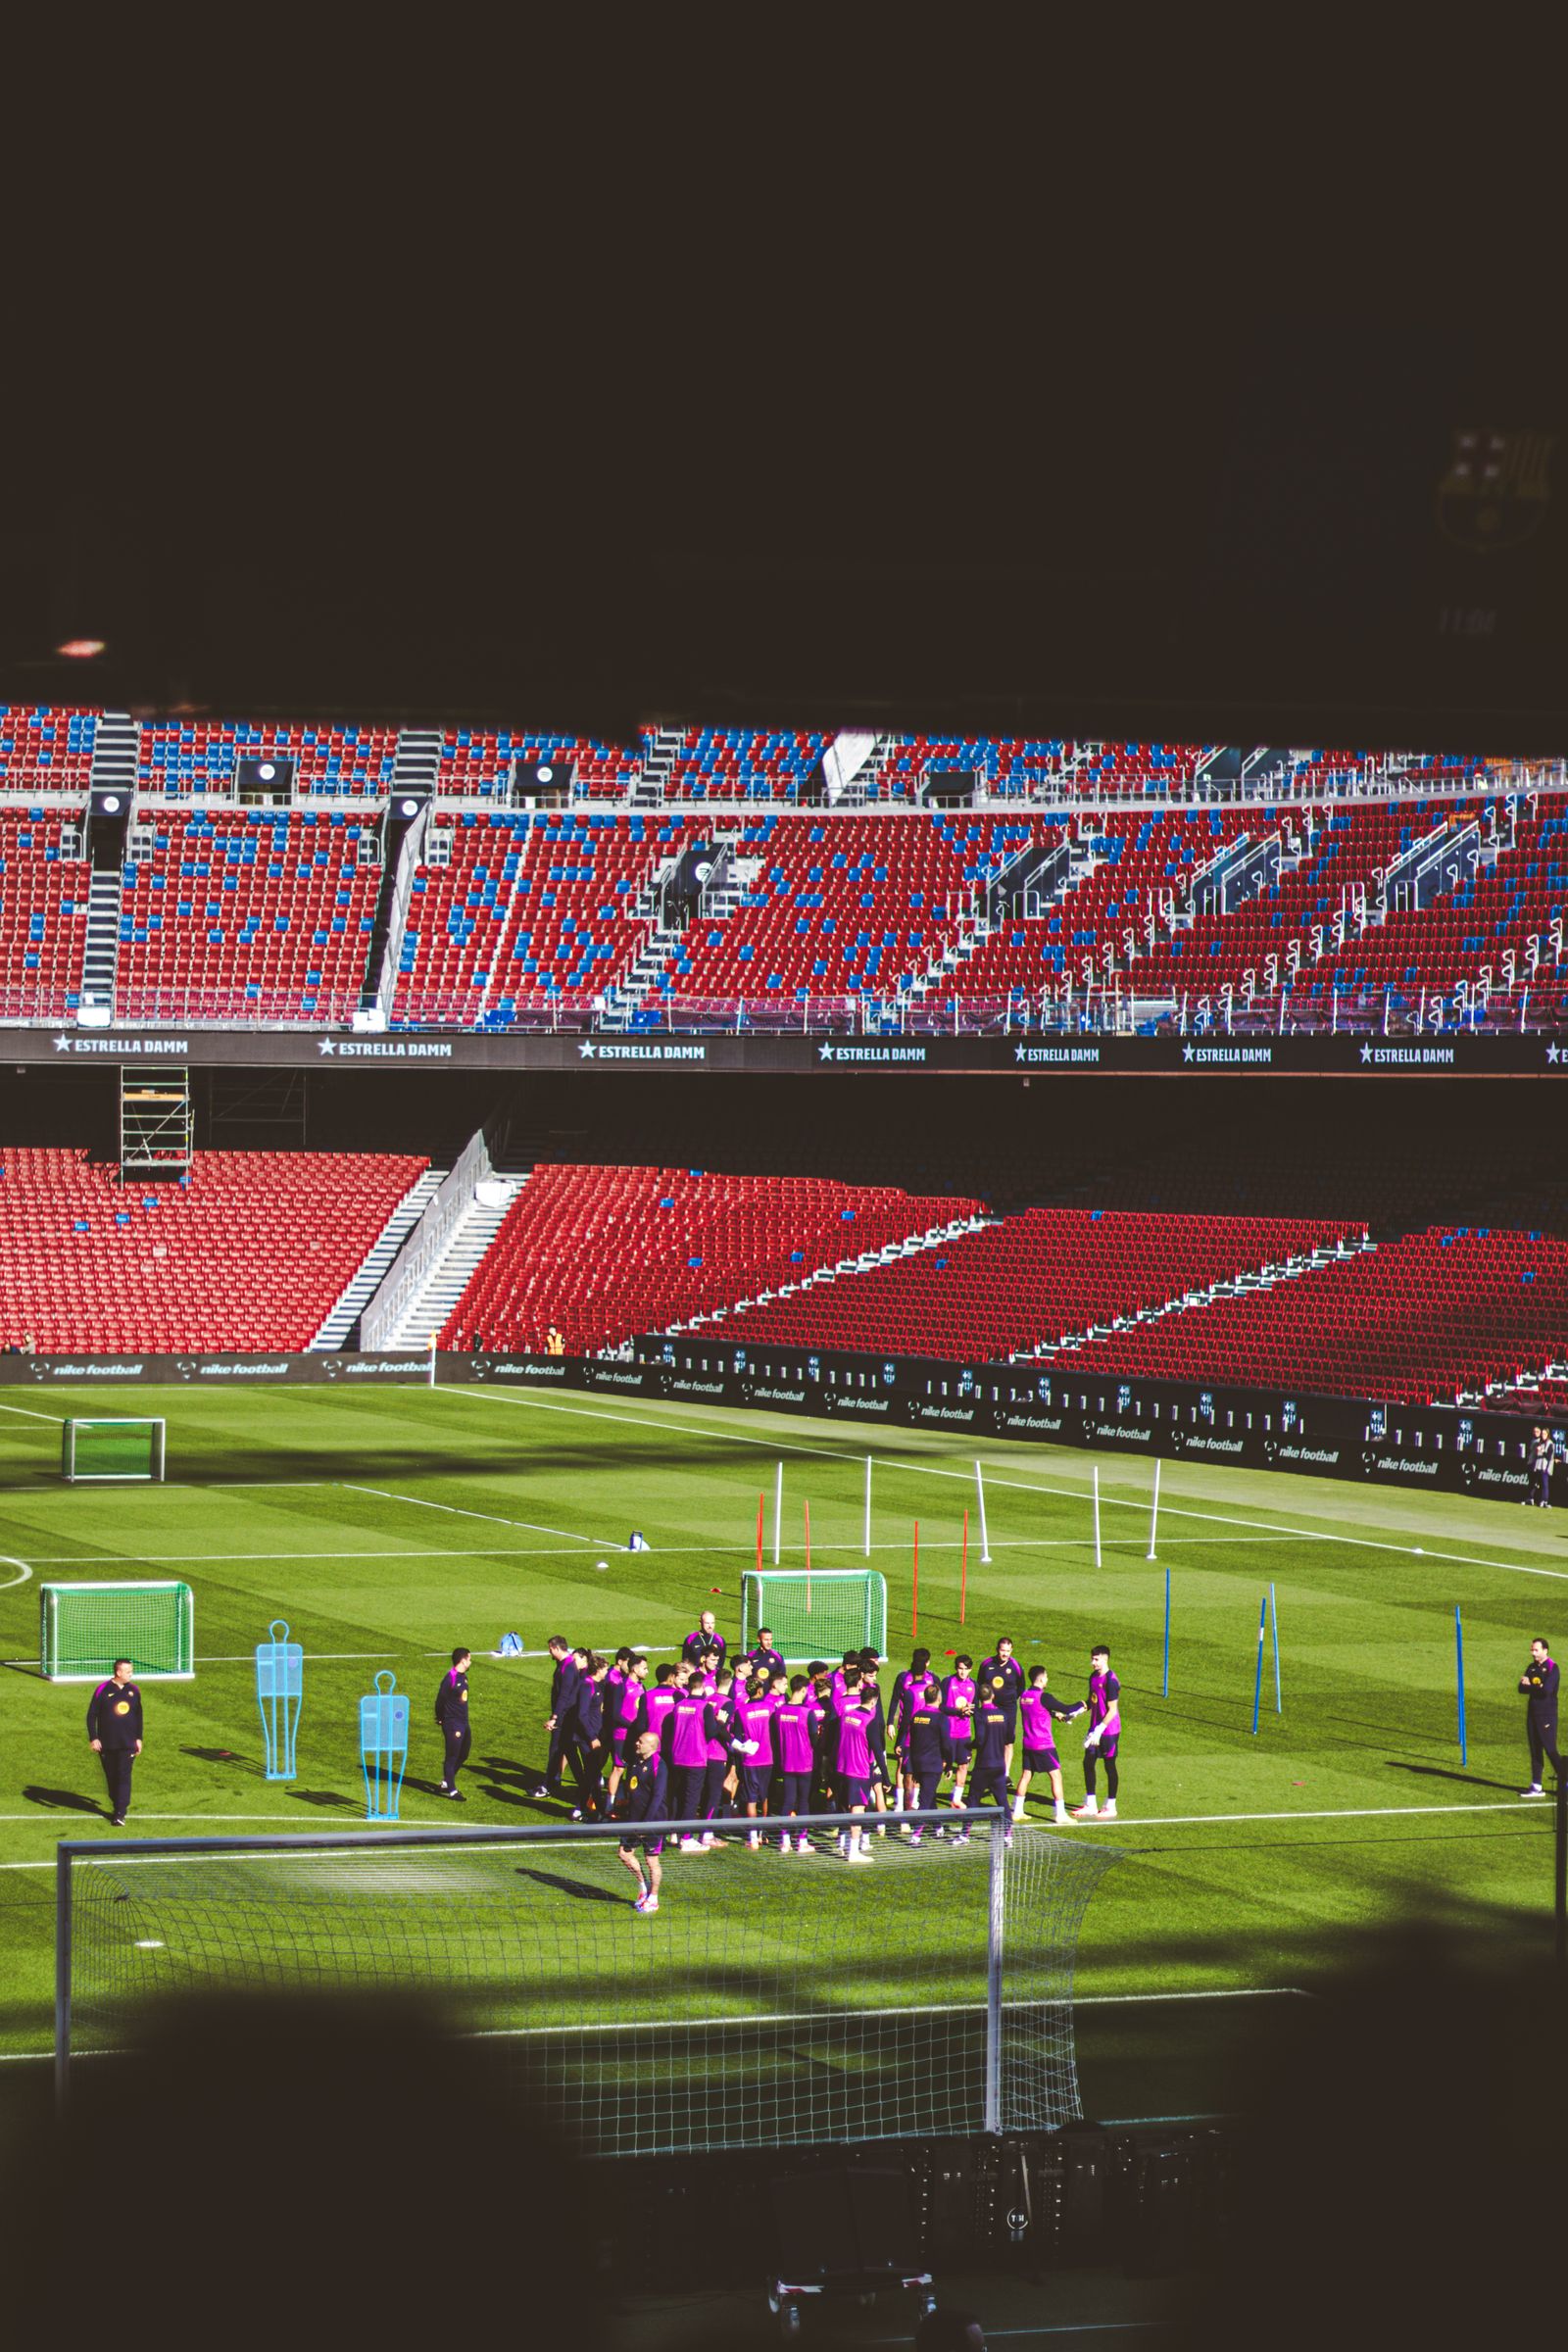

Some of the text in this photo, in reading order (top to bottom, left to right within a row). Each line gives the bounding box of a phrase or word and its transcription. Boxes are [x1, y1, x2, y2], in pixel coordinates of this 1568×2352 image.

[74, 1038, 189, 1054] ESTRELLA DAMM
[338, 1042, 453, 1057] ESTRELLA DAMM
[598, 1045, 706, 1059] ESTRELLA DAMM
[836, 1047, 926, 1061] ESTRELLA DAMM
[1027, 1048, 1100, 1062] ESTRELLA DAMM
[1196, 1048, 1272, 1062] ESTRELLA DAMM
[1374, 1049, 1454, 1063] ESTRELLA DAMM
[53, 1363, 143, 1376] nike football
[200, 1363, 288, 1375] nike football
[346, 1362, 377, 1373] nike
[495, 1363, 565, 1376] nike football
[596, 1371, 643, 1385] nike football
[673, 1380, 723, 1394] nike football
[755, 1387, 805, 1402] nike football
[837, 1396, 889, 1411] nike football
[921, 1406, 974, 1421] nike football
[1007, 1415, 1062, 1431] nike football
[1097, 1425, 1152, 1442] nike football
[1186, 1436, 1243, 1452] nike football
[1279, 1446, 1340, 1463] nike football
[1377, 1457, 1438, 1475] nike football
[1478, 1469, 1502, 1483] nike
